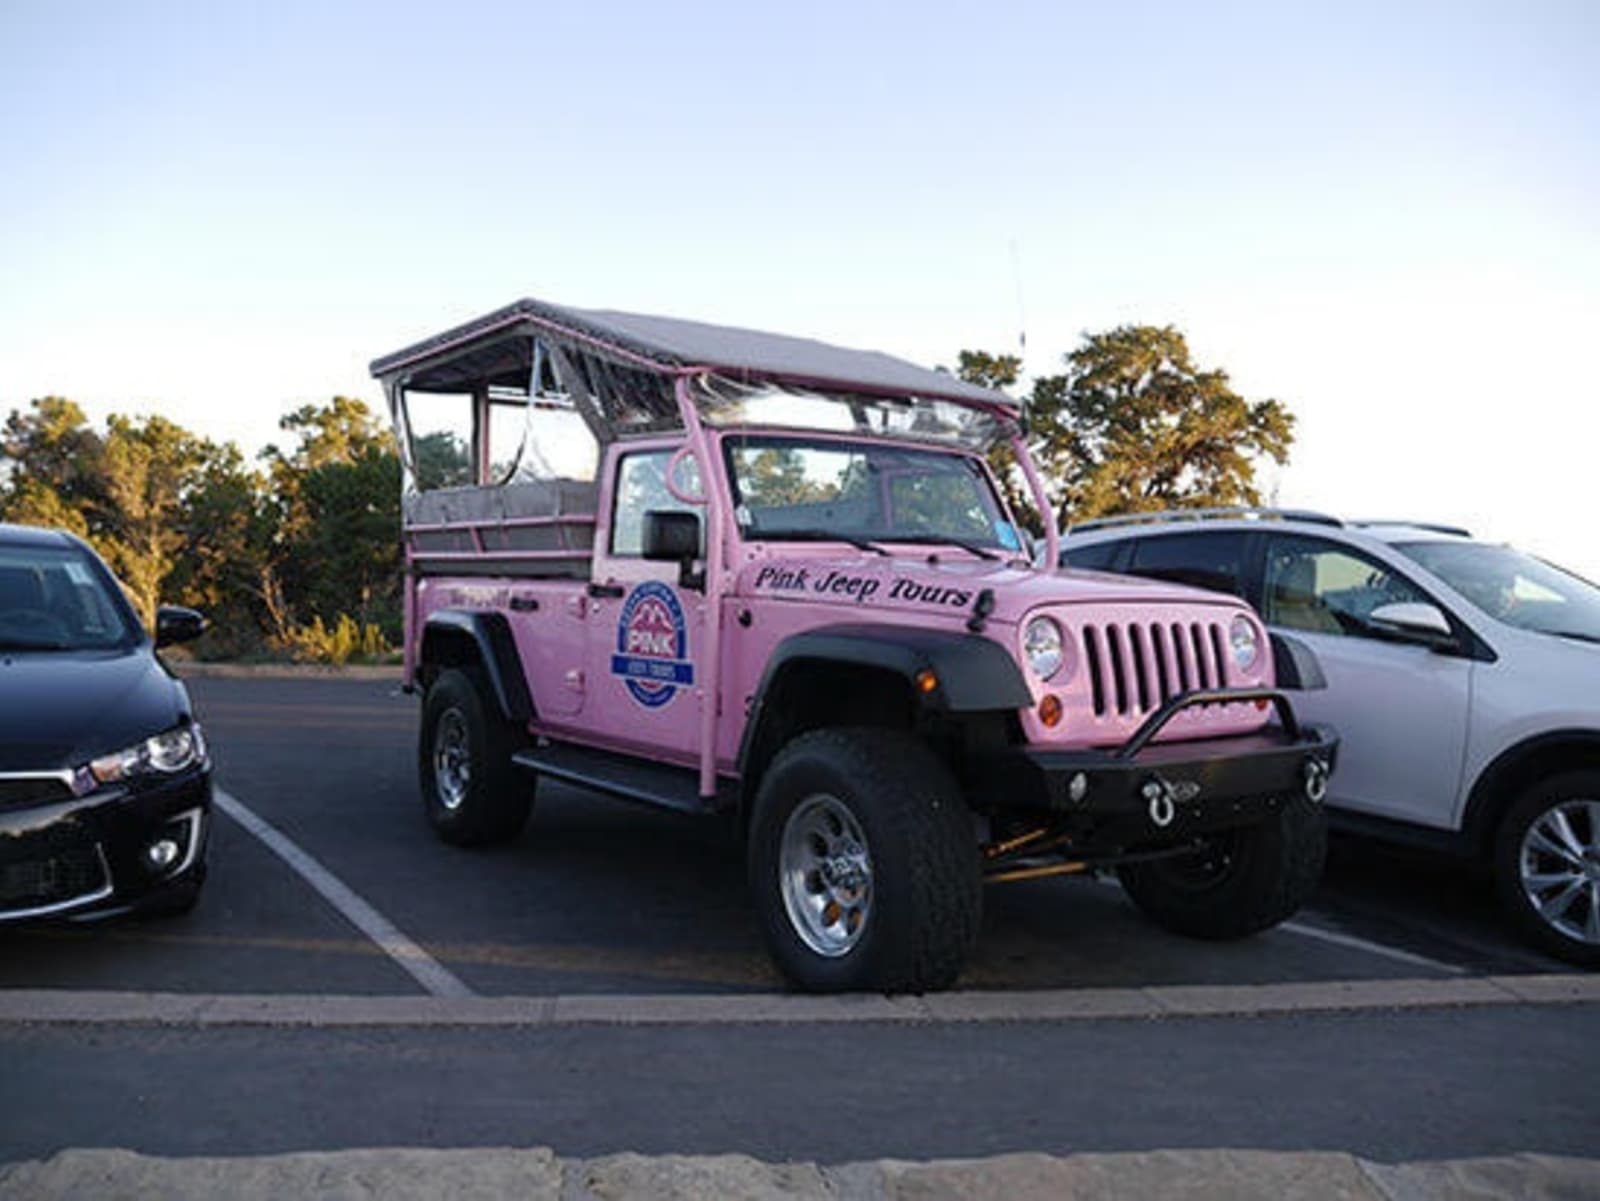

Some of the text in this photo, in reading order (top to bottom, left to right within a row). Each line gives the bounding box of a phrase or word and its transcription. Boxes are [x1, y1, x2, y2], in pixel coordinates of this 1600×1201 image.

[755, 567, 972, 607] Pink Jeep Tours
[627, 630, 675, 656] PINK
